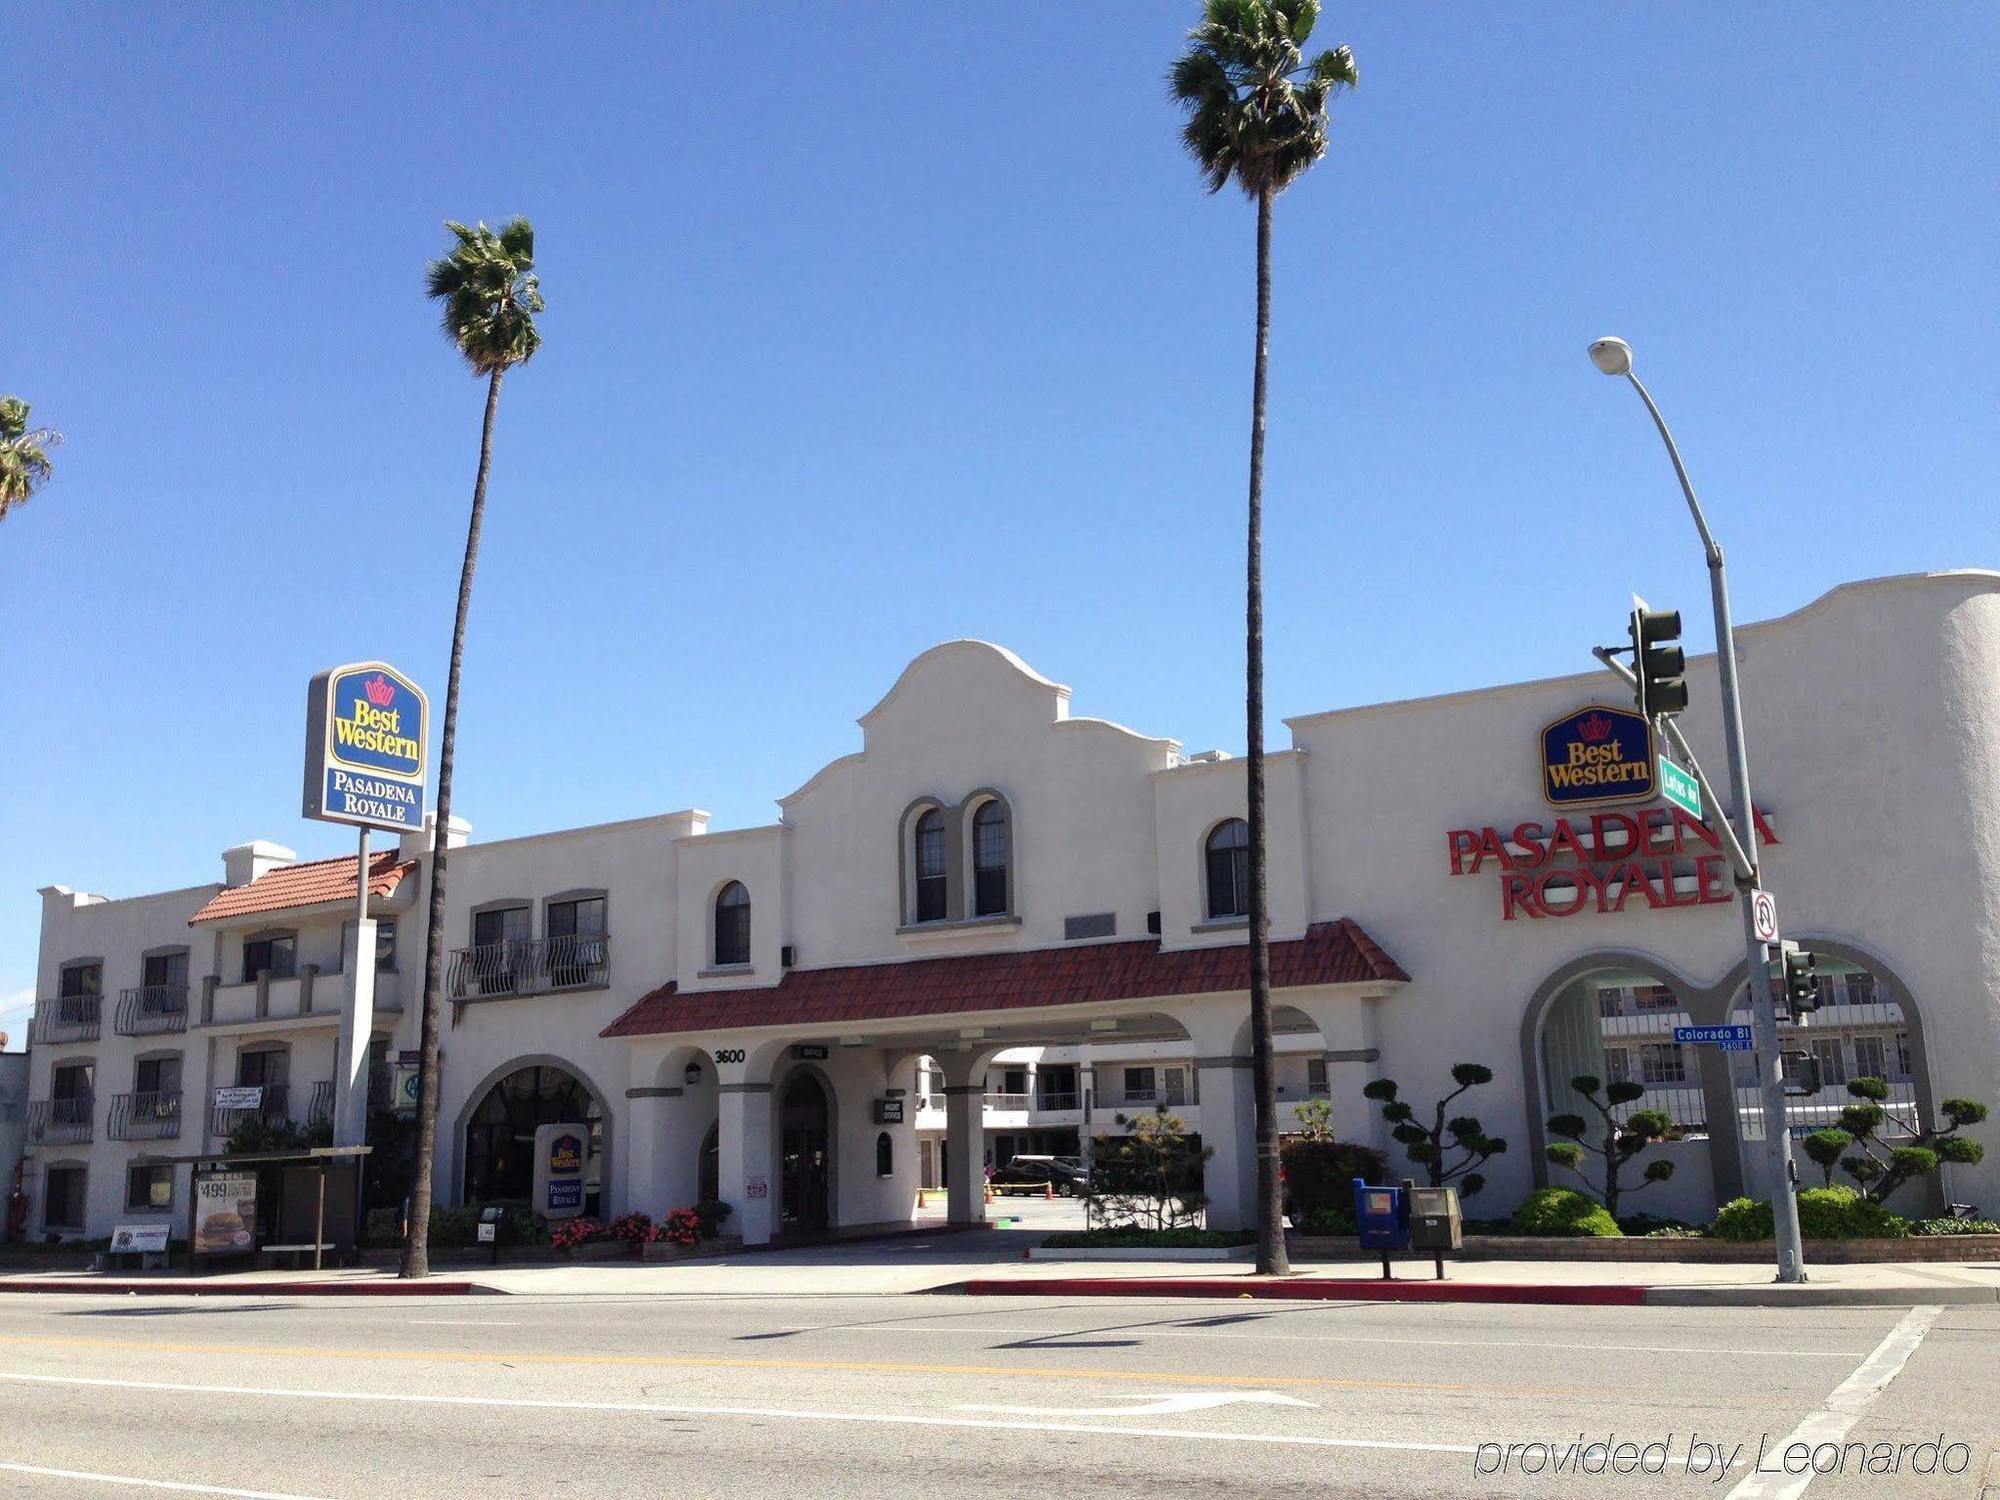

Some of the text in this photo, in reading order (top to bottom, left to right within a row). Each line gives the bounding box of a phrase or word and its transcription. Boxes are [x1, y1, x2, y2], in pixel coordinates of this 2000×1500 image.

[354, 699, 400, 733] Best
[335, 717, 418, 760] Western
[1567, 739, 1623, 766] Best
[334, 771, 416, 805] PASADENA
[1548, 760, 1650, 789] Western
[344, 793, 405, 822] ROYALE
[1500, 855, 1734, 920] ROYALE
[1677, 1028, 1732, 1040] Colorado
[715, 1049, 745, 1064] 3600
